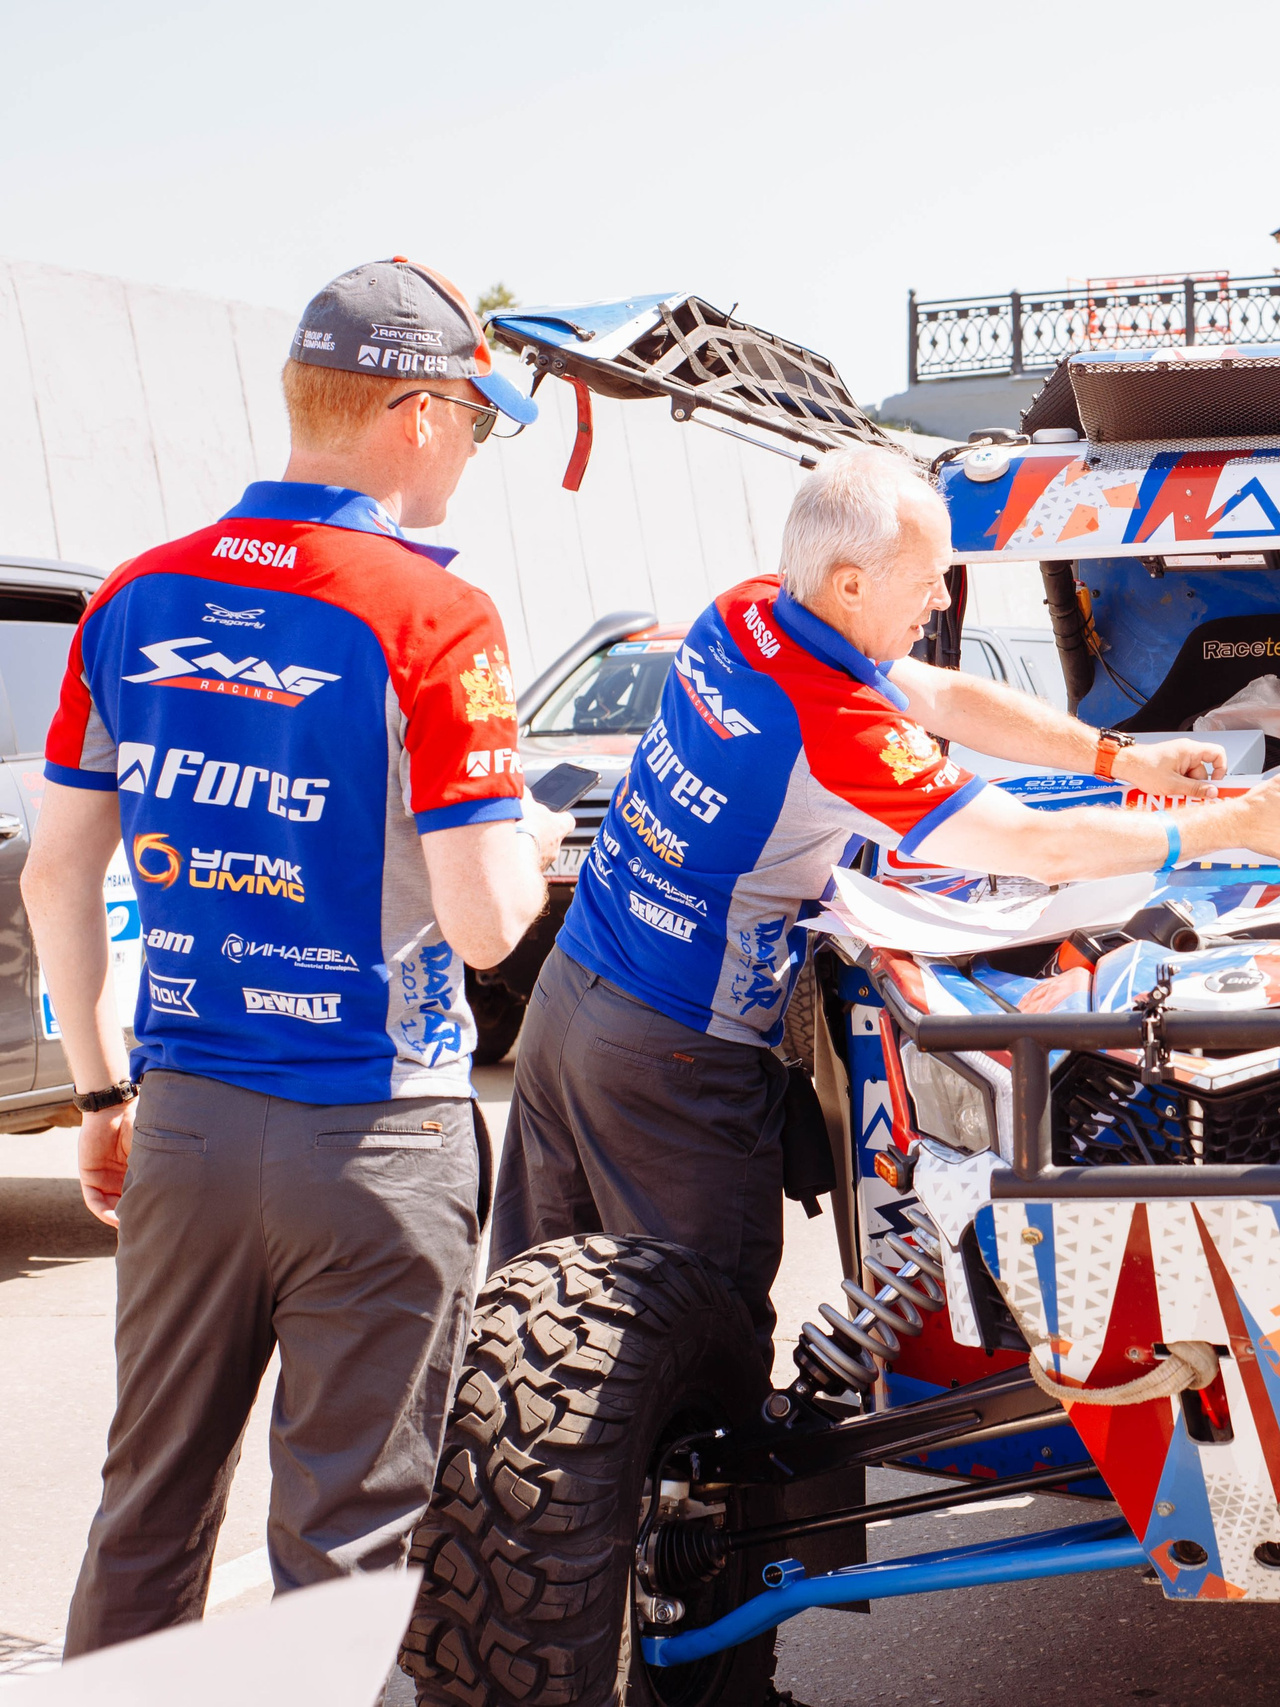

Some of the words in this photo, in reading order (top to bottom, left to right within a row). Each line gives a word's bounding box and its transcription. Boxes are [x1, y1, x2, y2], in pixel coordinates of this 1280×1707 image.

[379, 328, 438, 342] RAVENOL
[381, 348, 448, 372] Fores
[212, 536, 298, 569] RUSSIA
[742, 602, 781, 659] RUSSIA
[122, 637, 342, 697] SNAG
[200, 681, 274, 700] RACING
[686, 687, 715, 725] RACING
[155, 749, 331, 822] Fores
[641, 719, 728, 824] Fores
[1025, 779, 1084, 787] 2019
[622, 803, 684, 868] UMMC
[189, 868, 305, 903] UMMC
[143, 928, 195, 954] -am
[400, 962, 419, 1010] 201
